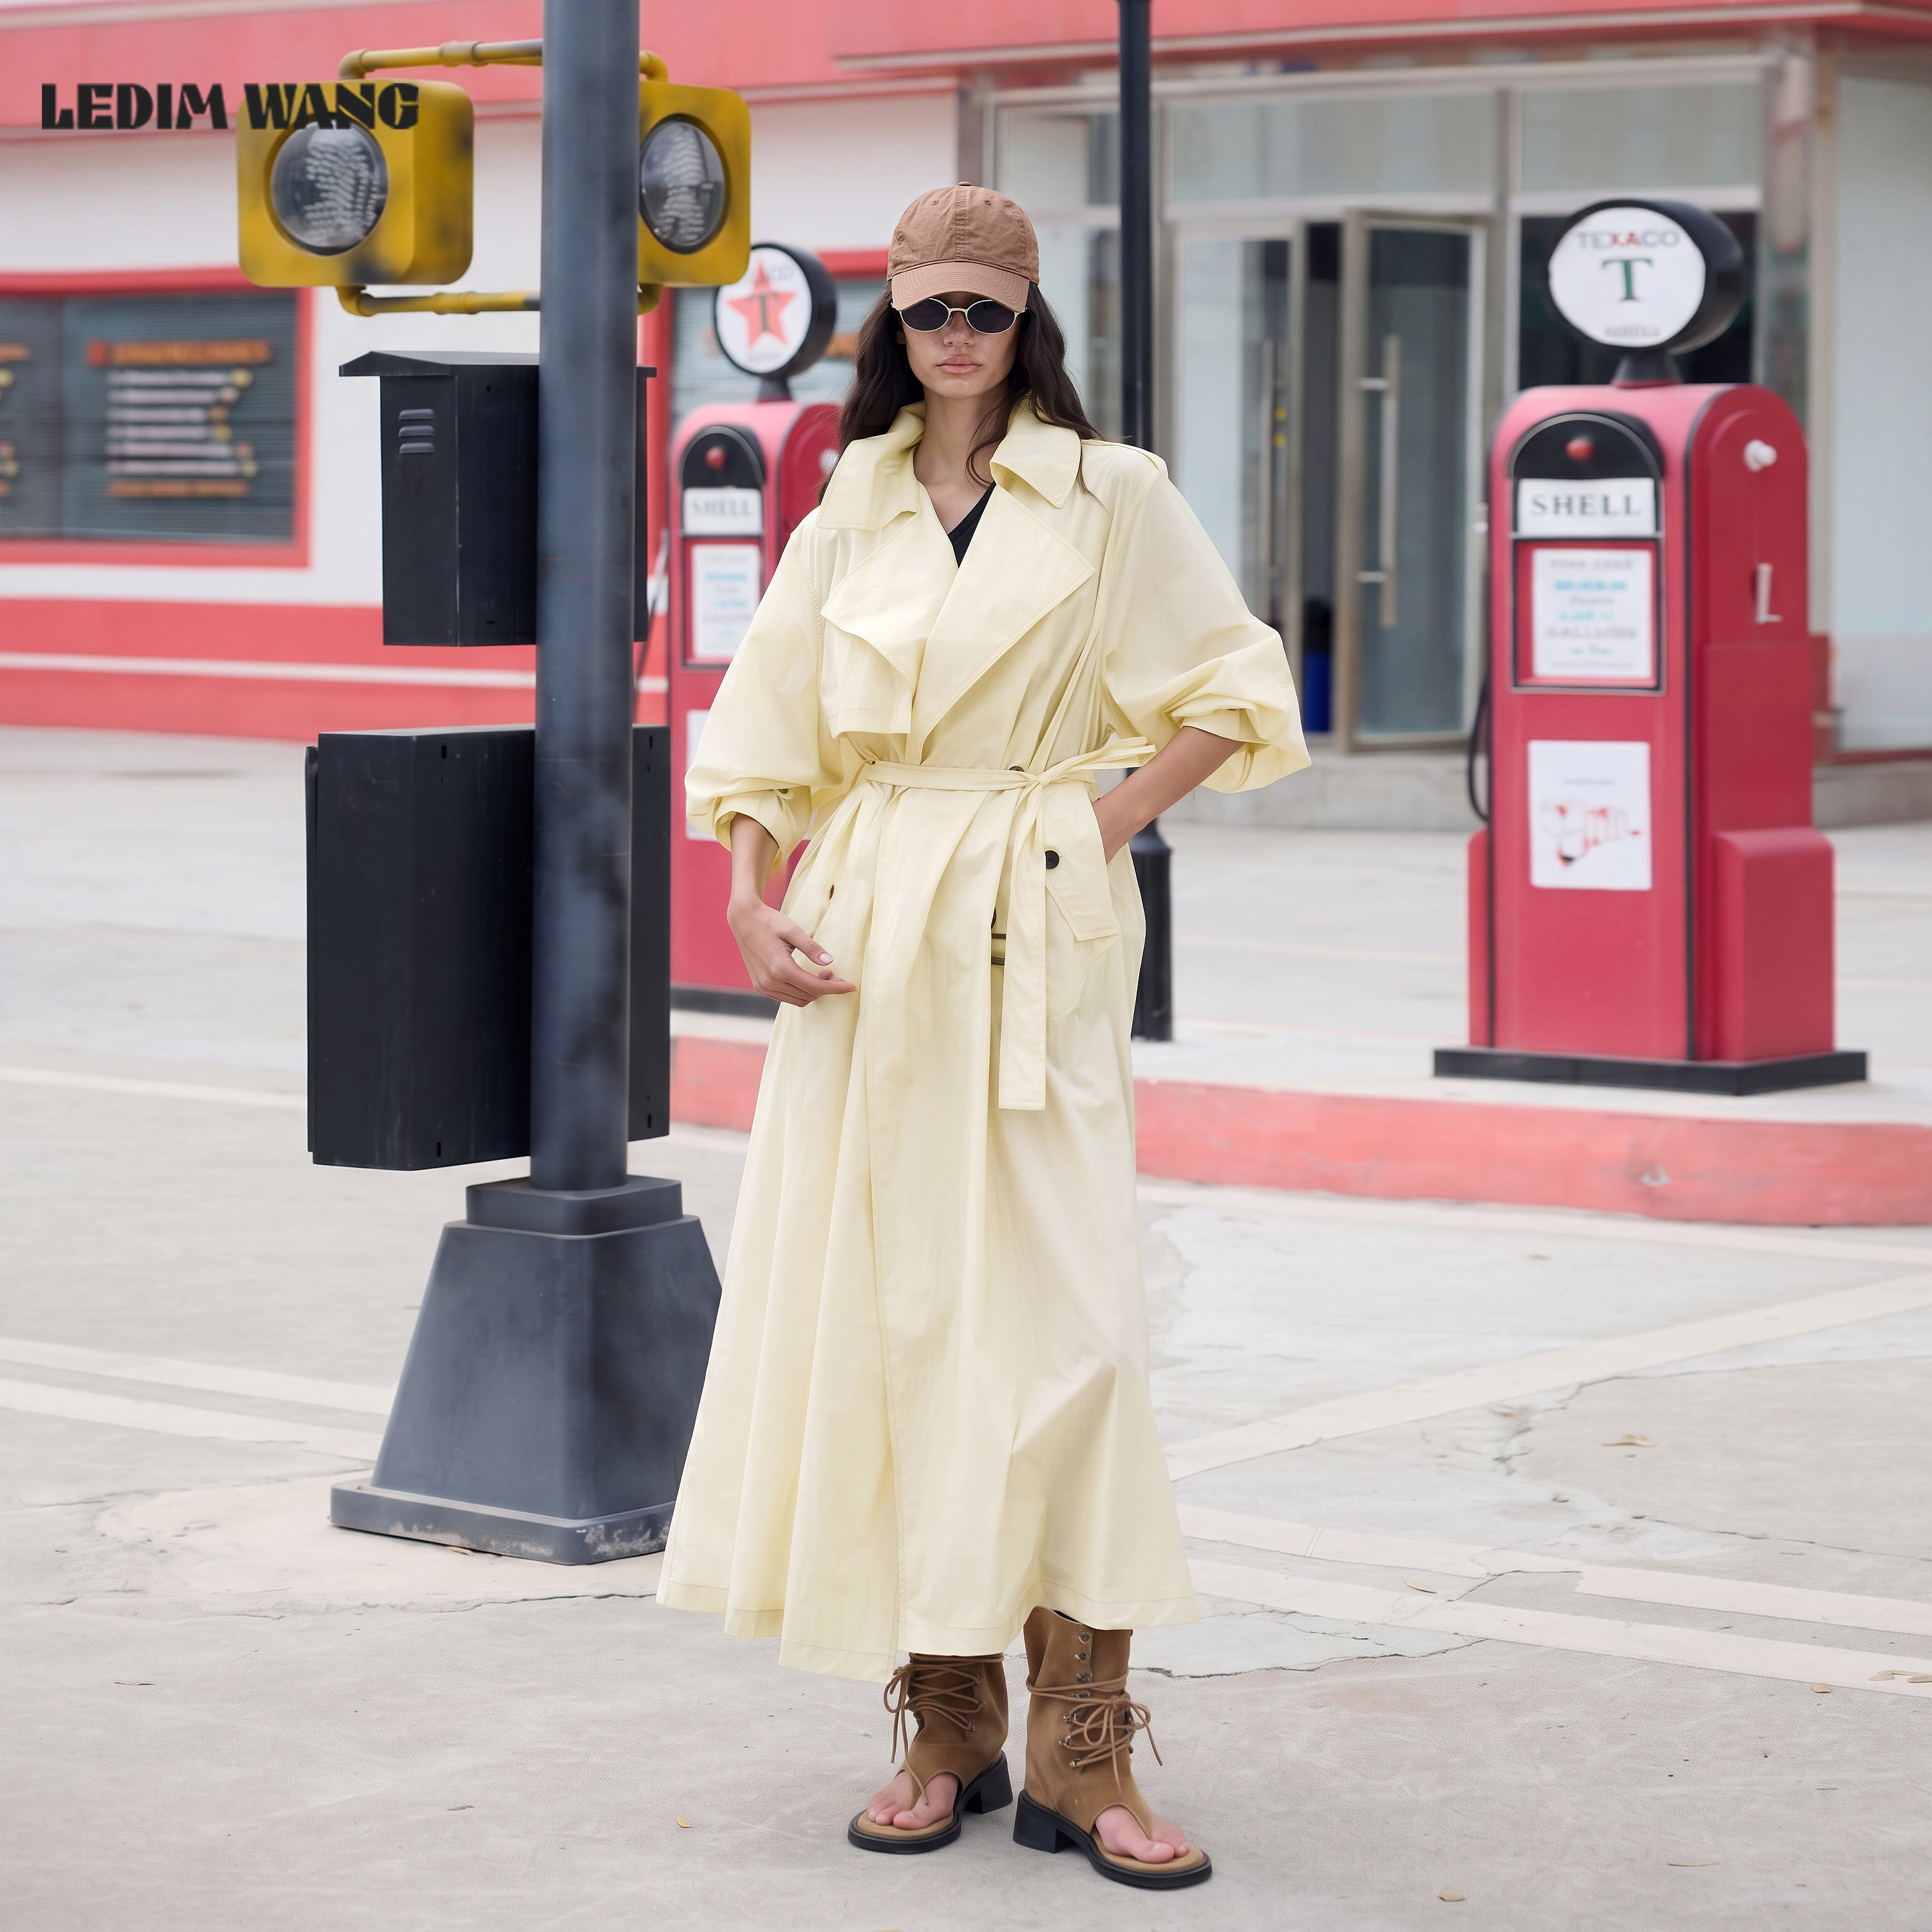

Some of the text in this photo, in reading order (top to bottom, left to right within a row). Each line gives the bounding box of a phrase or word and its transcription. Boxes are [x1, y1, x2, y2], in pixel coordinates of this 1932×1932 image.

[1578, 229, 1680, 250] TEXACO
[1600, 258, 1654, 303] T
[1531, 494, 1641, 516] SHELL
